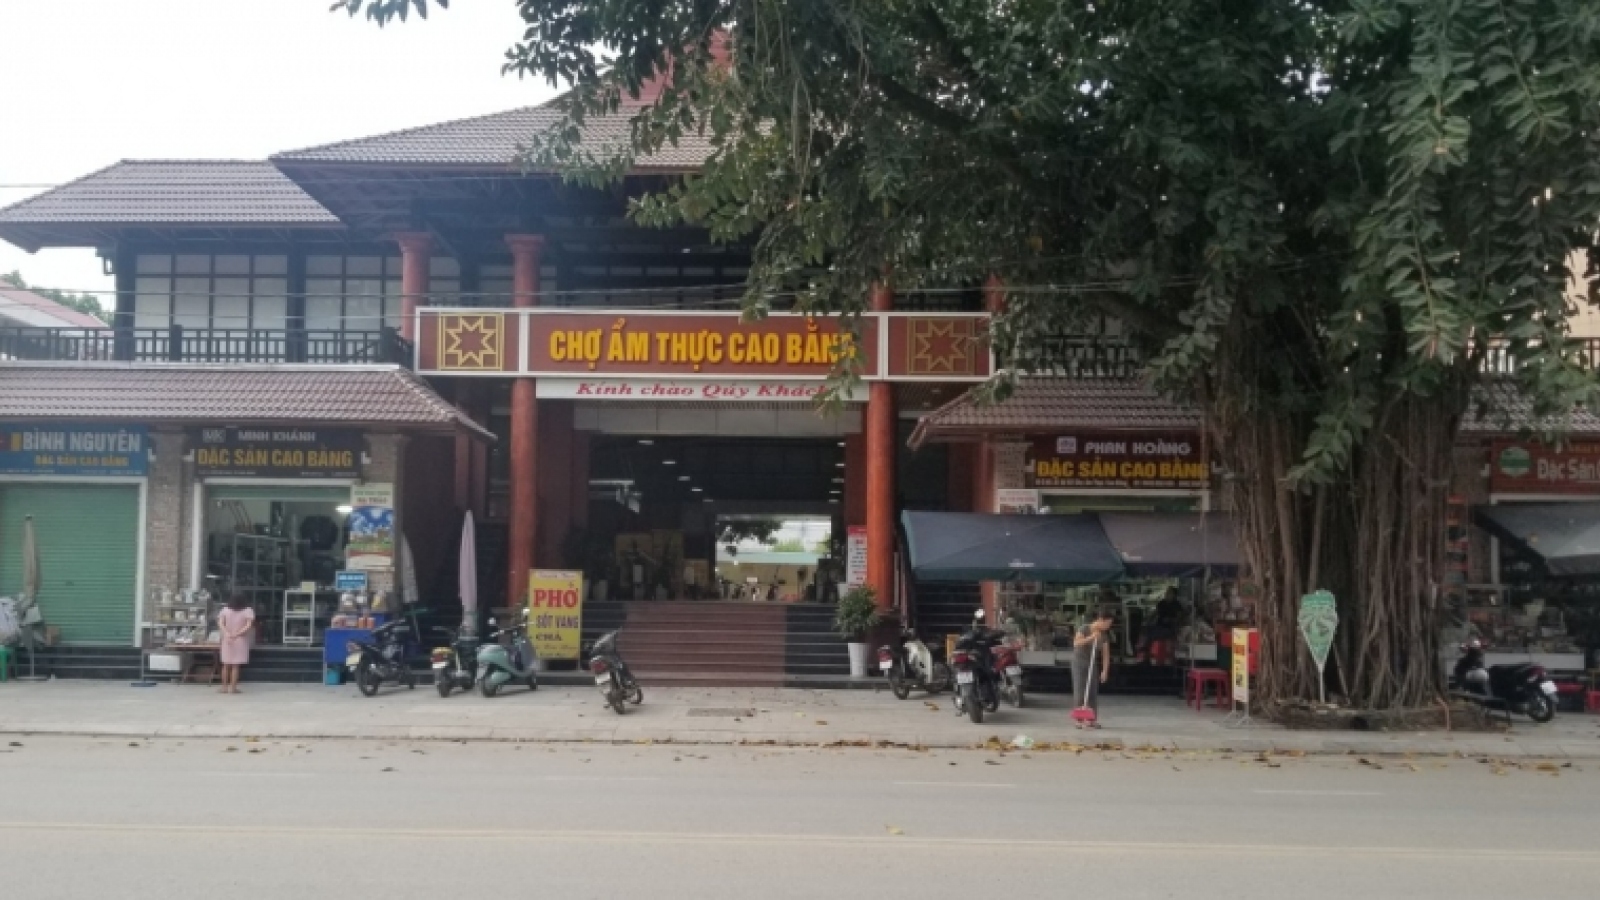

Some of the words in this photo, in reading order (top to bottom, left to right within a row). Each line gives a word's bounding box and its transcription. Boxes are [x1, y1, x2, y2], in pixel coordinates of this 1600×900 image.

[549, 328, 602, 370] CHỢ
[607, 317, 649, 362] ẨM
[655, 330, 722, 371] THỰC
[728, 332, 779, 363] CAO
[576, 382, 632, 396] Kính
[640, 382, 694, 396] chào
[23, 427, 65, 451] BÌNH
[69, 428, 140, 452] NGUYÊN
[1084, 441, 1127, 454] PHAN
[234, 444, 268, 466] SẢN
[272, 451, 304, 466] CAO
[307, 444, 353, 467] BẰNG
[1078, 456, 1118, 477] SẢN
[1120, 462, 1157, 477] CAO
[533, 581, 579, 608] PHỞ
